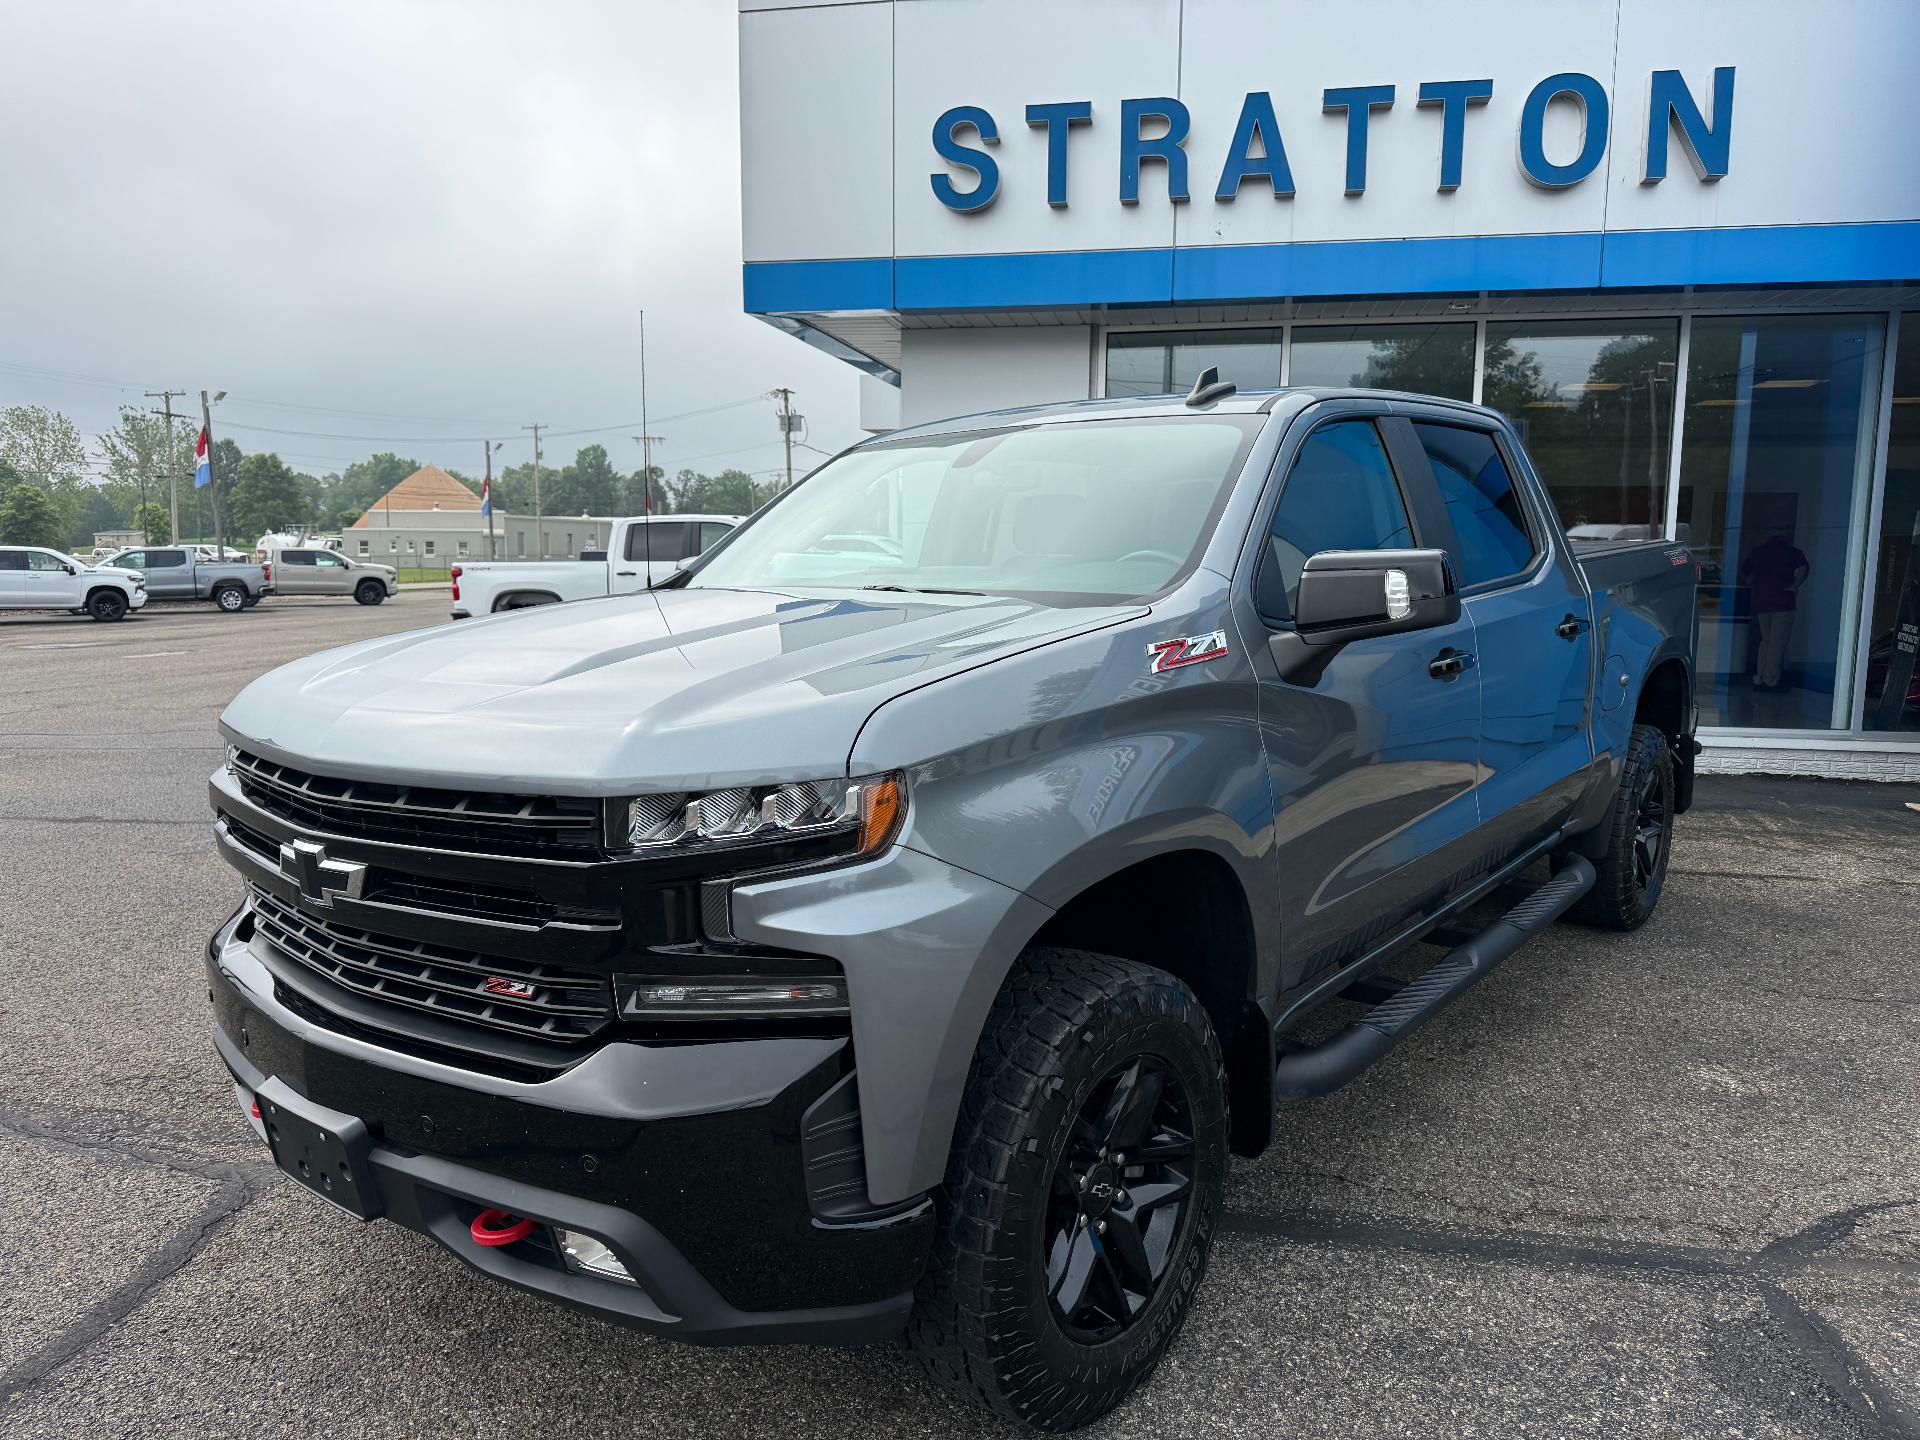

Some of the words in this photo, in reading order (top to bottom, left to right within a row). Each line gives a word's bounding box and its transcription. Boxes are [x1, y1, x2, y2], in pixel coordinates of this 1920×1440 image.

[930, 66, 1737, 215] STRATTON
[1145, 629, 1229, 675] Z71
[483, 977, 535, 998] Z71
